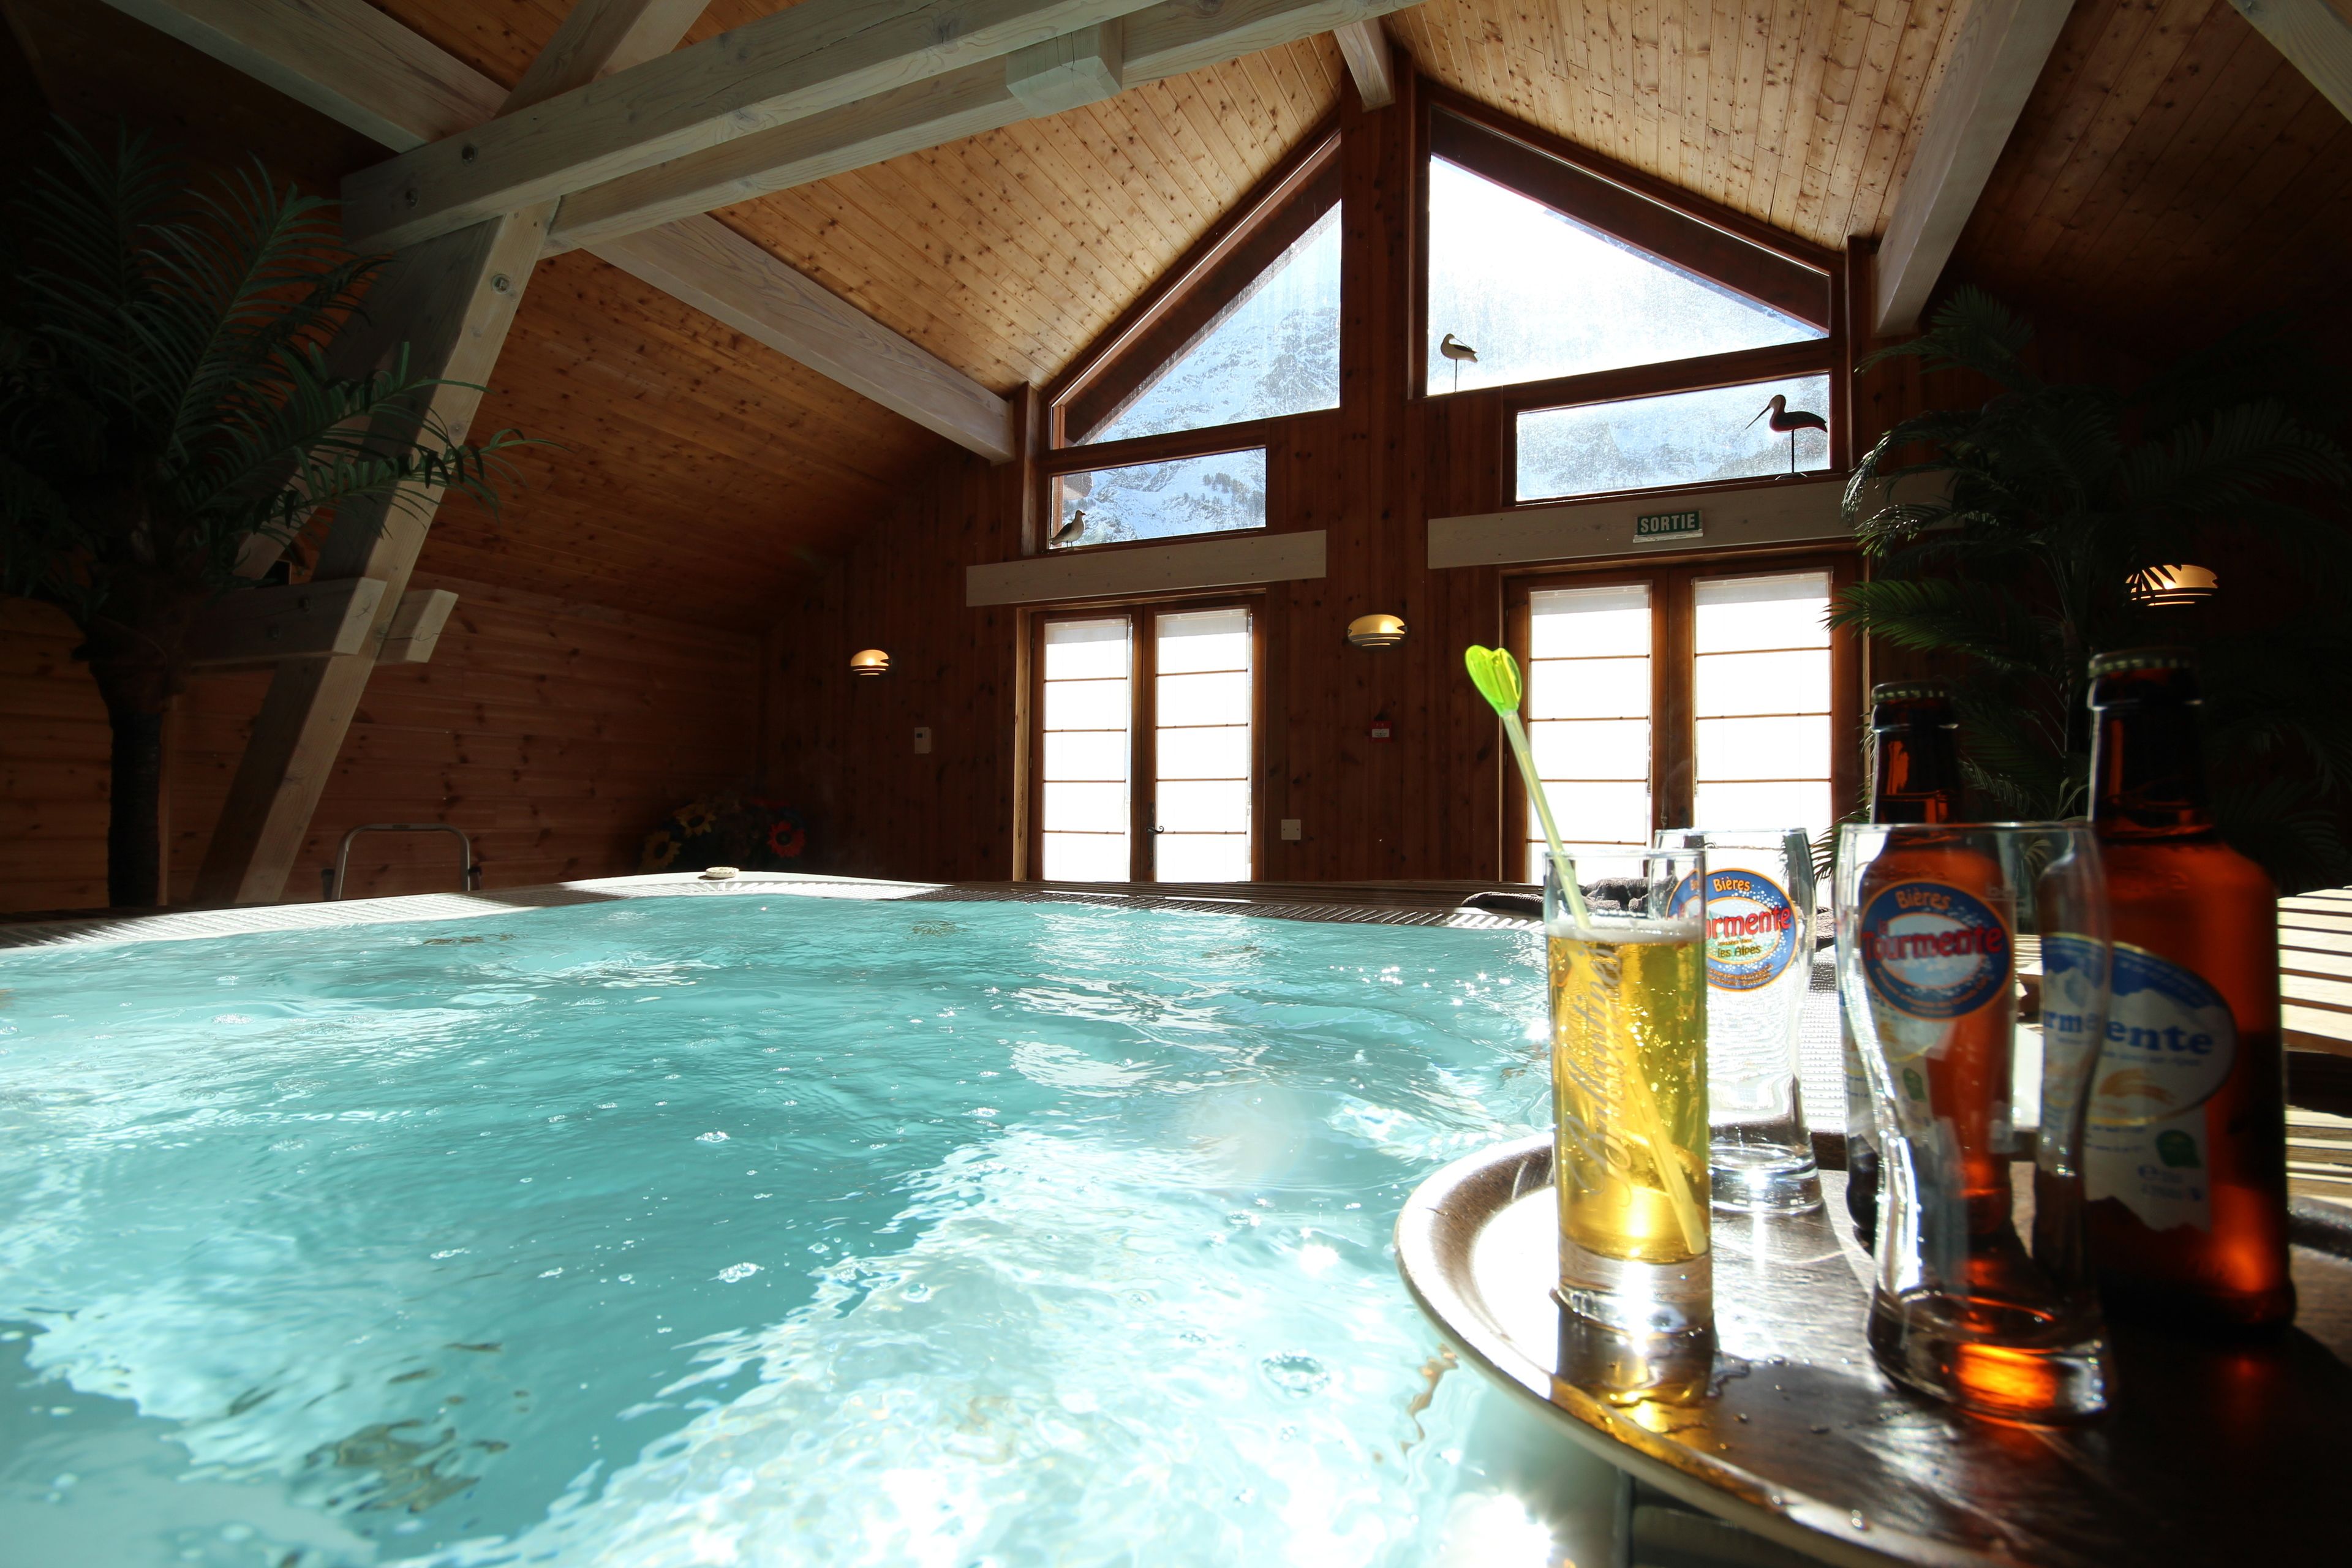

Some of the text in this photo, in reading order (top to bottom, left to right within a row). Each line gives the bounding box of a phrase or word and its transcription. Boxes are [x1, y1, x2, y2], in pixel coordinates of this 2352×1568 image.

[1640, 513, 1695, 533] SORTIE
[1713, 876, 1751, 892] Bières
[1895, 887, 1951, 910] Bières
[1706, 906, 1792, 940] rmente
[1735, 946, 1762, 956] Alpes
[1862, 923, 2003, 961] Tourmente
